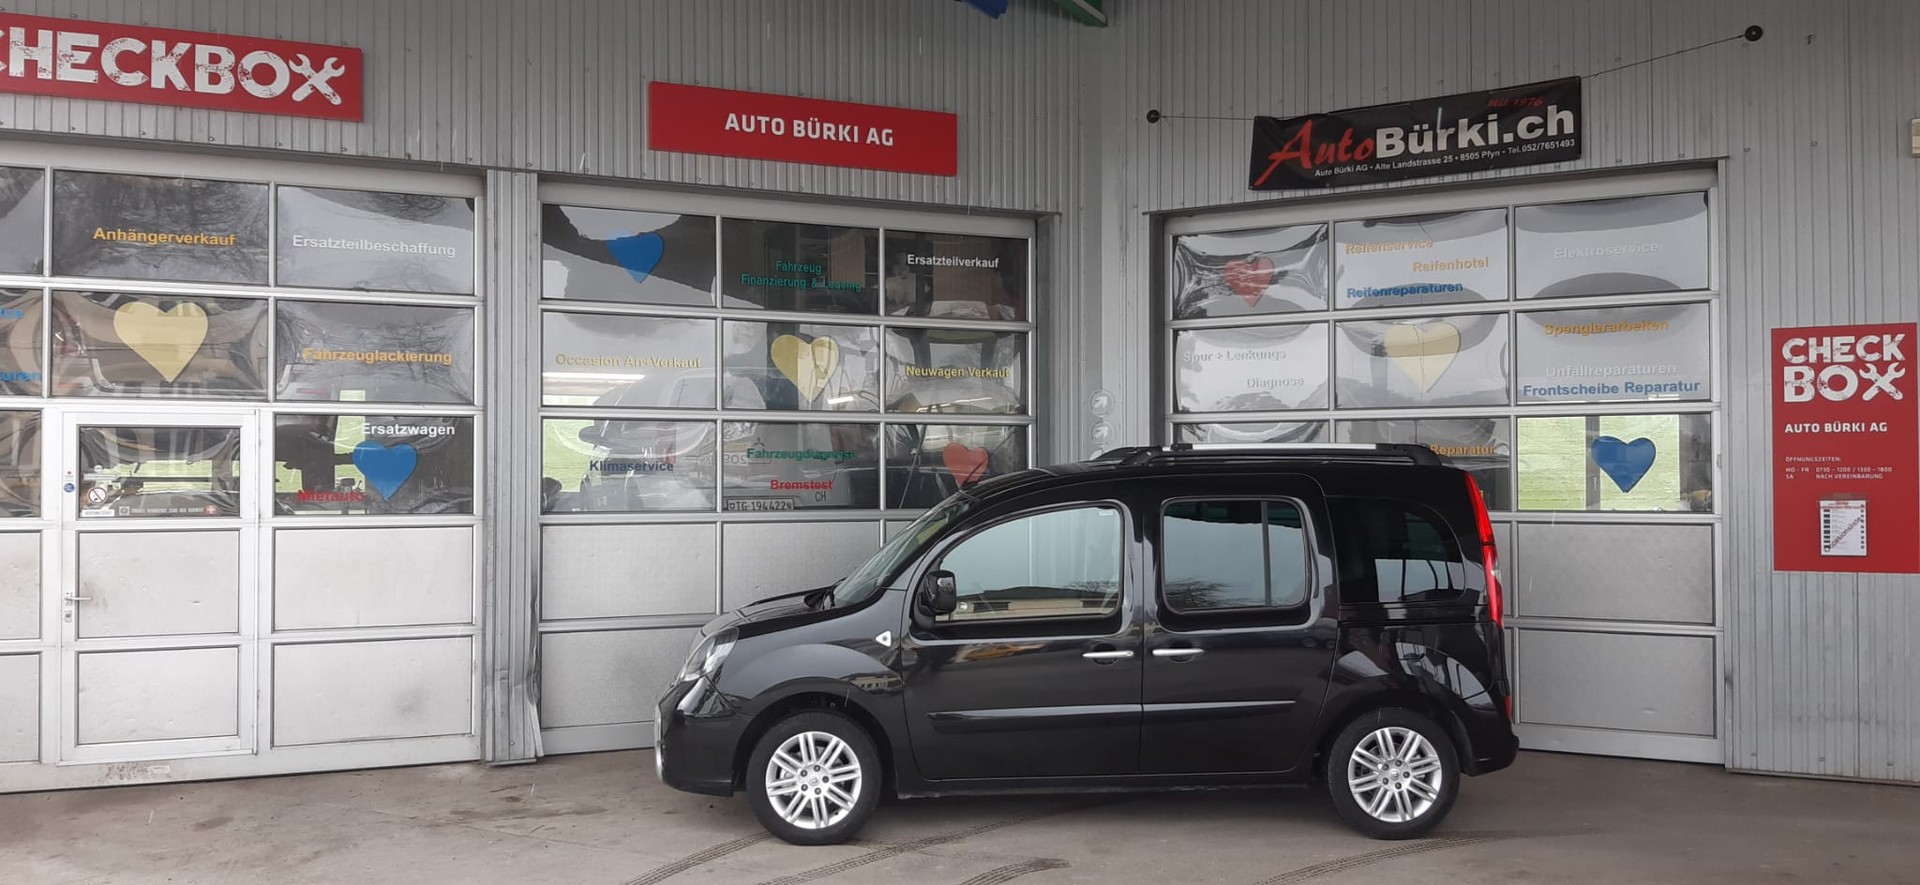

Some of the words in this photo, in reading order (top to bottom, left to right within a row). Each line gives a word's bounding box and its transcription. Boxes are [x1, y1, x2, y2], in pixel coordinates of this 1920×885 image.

[0, 26, 346, 105] HECKBOX
[725, 113, 785, 136] AUTO
[793, 117, 859, 143] BÜRKI
[866, 127, 894, 146] AG
[1314, 169, 1333, 177] Auto
[1334, 164, 1354, 175] Bürki
[1355, 164, 1368, 172] AG
[1375, 163, 1391, 171] Alte
[1392, 157, 1441, 170] Landstrasse
[1443, 155, 1453, 163] 25
[1460, 151, 1480, 161] 8505
[1481, 149, 1501, 160] Pfyn
[93, 226, 236, 247] Anhängerverkauf
[292, 234, 457, 258] Ersatzteilbeschaffung
[1345, 238, 1434, 255] Reifenservice
[1553, 242, 1660, 260] Elektroservice
[775, 260, 822, 275] Fahrzeug
[907, 253, 1000, 269] Ersatzteilverkauf
[1412, 257, 1489, 273] Reifenhotel
[741, 273, 807, 290] Finanzierung
[811, 278, 819, 288] &
[823, 278, 862, 292] Leasing
[1346, 281, 1464, 299] Reifenreparaturen
[1543, 319, 1669, 337] Spenglerarbeiten
[1183, 351, 1213, 363] Spur
[1226, 349, 1287, 362] Lenkungs
[1782, 333, 1906, 364] CHECK
[303, 348, 453, 366] Fahrzeuglackierung
[555, 353, 620, 367] Occasion
[906, 365, 965, 380] Neuwagen
[967, 366, 1010, 379] Verkauf
[1546, 362, 1677, 378] Unfallreparaturen
[1246, 377, 1305, 390] Diagnose
[1523, 383, 1620, 397] Frontscheibe
[1624, 380, 1701, 396] Reparatur
[1783, 362, 1906, 403] BOX
[361, 423, 456, 438] Ersatzwagen
[1784, 423, 1820, 433] AUTO
[1824, 420, 1866, 433] BÜRKI
[1869, 422, 1888, 432] AG
[747, 448, 858, 461] Fahrzeugdiagnose
[1430, 443, 1495, 457] Reparatur
[589, 460, 674, 472] Klimaservice
[770, 479, 834, 491] Bremstest
[297, 490, 366, 503] Mietauto
[815, 491, 827, 502] CH
